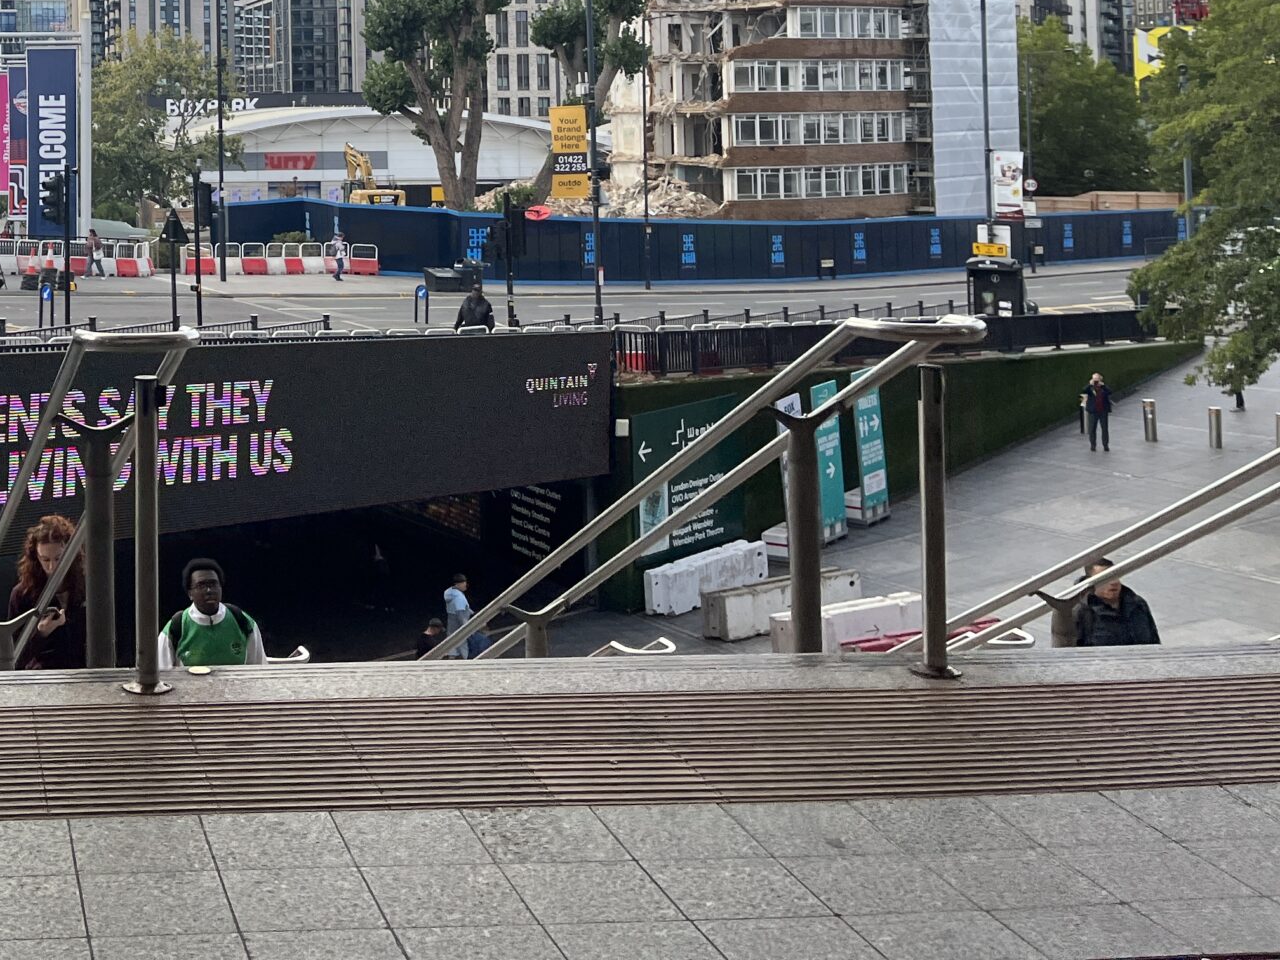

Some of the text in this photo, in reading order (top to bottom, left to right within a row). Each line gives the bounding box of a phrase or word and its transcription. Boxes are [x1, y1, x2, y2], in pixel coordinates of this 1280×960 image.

[165, 97, 260, 117] BOXPRK
[557, 125, 581, 133] Brand
[554, 134, 586, 142] Belongs
[558, 156, 583, 164] 01422
[554, 163, 587, 172] 322 255
[681, 252, 696, 264] Hill
[771, 252, 785, 264] Hill
[525, 374, 589, 393] QUINTAIN
[185, 379, 274, 428] THEY
[553, 391, 588, 408] LIVING
[156, 434, 238, 486] WITH
[249, 427, 294, 476] US
[671, 482, 690, 492] London
[671, 493, 684, 504] OVO
[672, 527, 724, 547] Wembley Park Theatre
